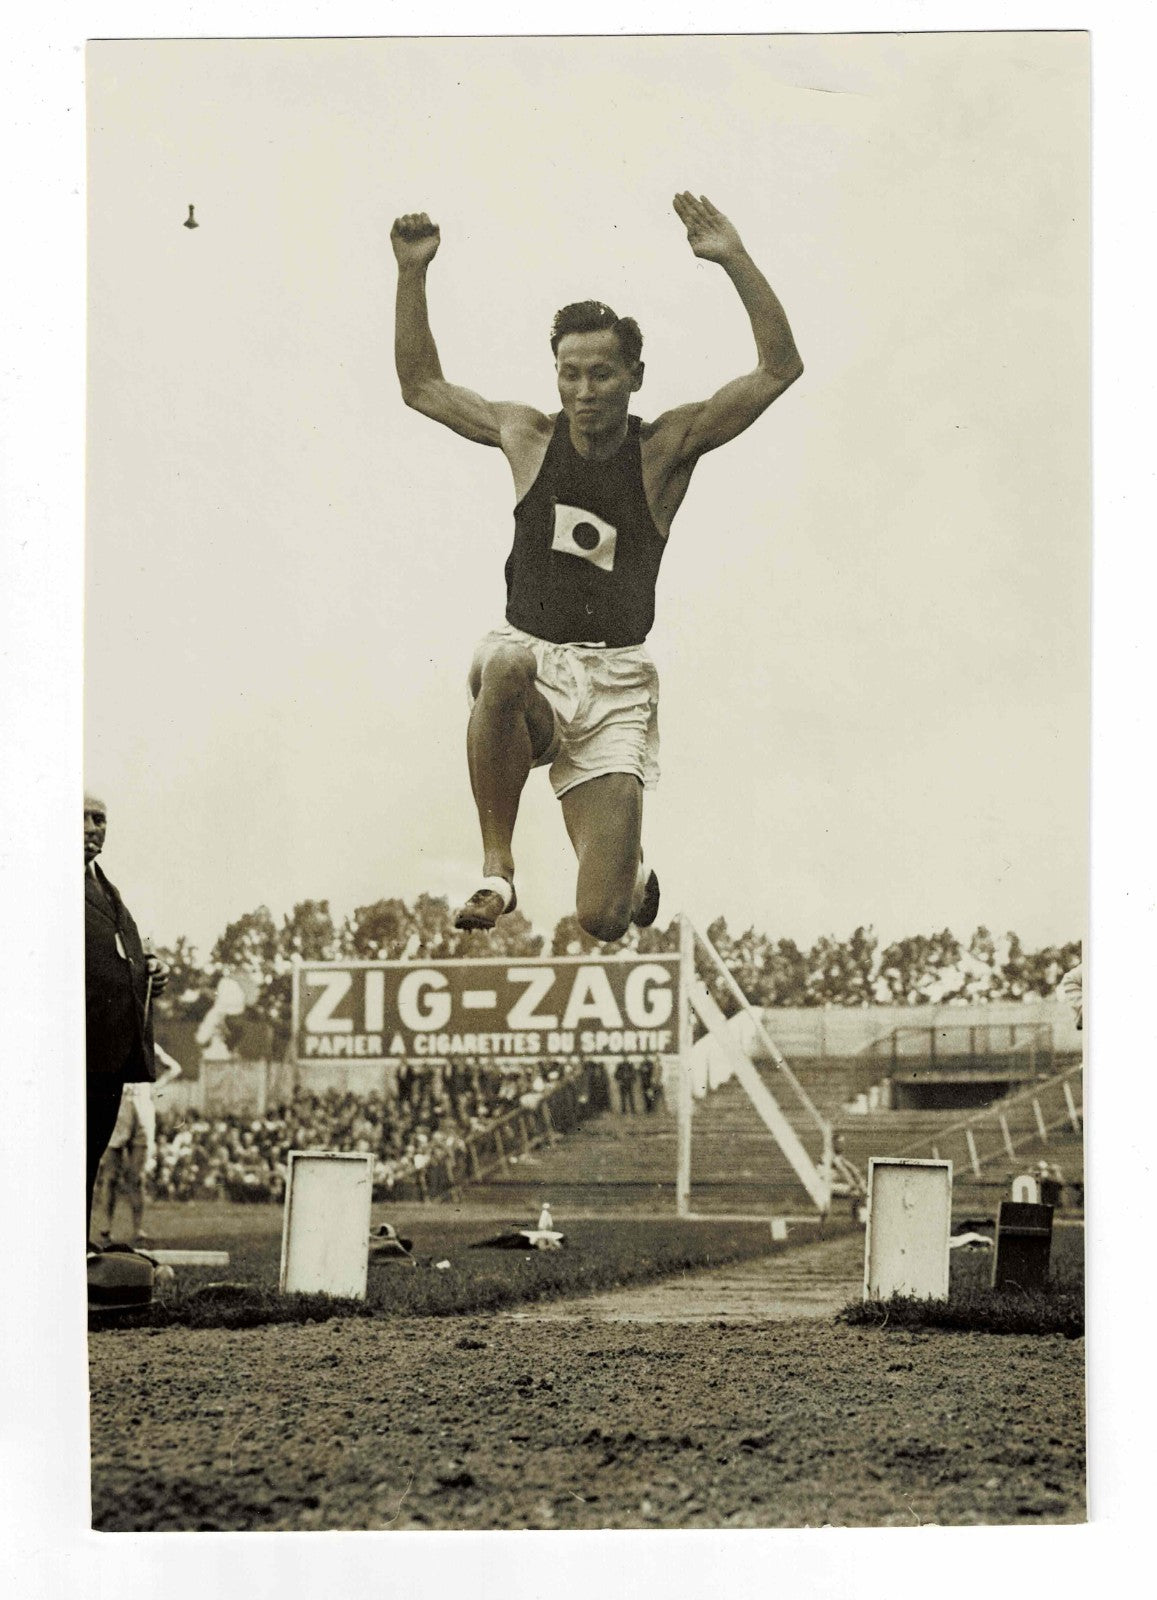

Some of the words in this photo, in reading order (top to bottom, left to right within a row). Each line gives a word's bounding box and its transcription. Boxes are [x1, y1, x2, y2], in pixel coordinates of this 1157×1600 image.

[305, 964, 673, 1032] ZIG-ZAG
[305, 1034, 383, 1056] PAPIER
[413, 1033, 540, 1055] CIGARETTES
[547, 1031, 575, 1053] DU
[580, 1030, 672, 1053] SPORTIF
